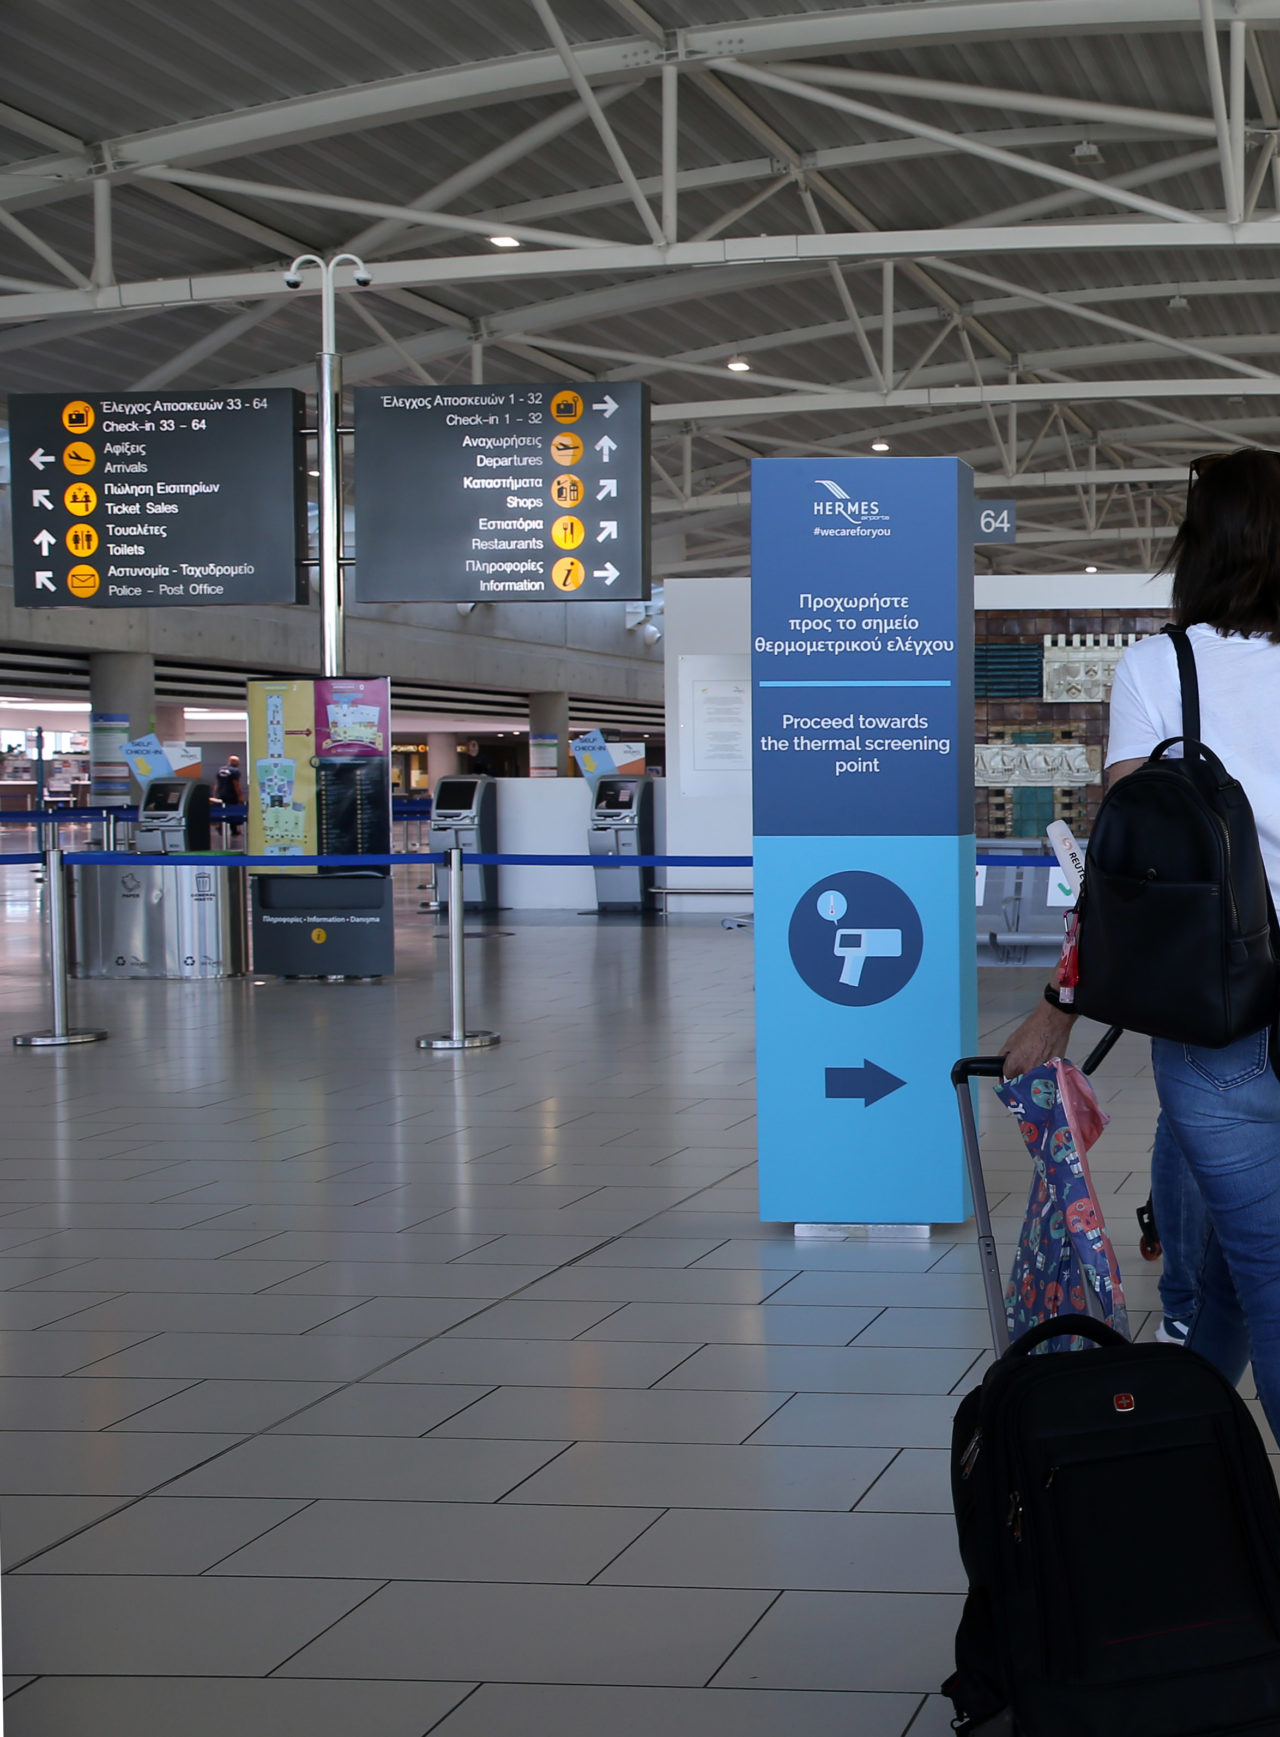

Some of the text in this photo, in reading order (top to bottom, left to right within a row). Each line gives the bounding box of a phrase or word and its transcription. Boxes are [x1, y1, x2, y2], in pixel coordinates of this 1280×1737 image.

[153, 400, 223, 411] Αποσκευών
[227, 399, 241, 409] 33
[253, 398, 267, 409] 64
[434, 394, 504, 405] Αποσκευών
[509, 394, 514, 404] 1
[528, 393, 542, 404] 32
[103, 421, 155, 432] Check-in
[160, 420, 175, 431] 33
[192, 419, 206, 430] 64
[446, 415, 498, 425] Check-in
[506, 414, 509, 424] 1
[529, 413, 542, 423] 32
[104, 442, 146, 455] Αφίξεις
[463, 435, 541, 449] Αναχωρήσεις
[105, 462, 147, 473] Arrivals
[477, 455, 543, 468] Departures
[105, 482, 219, 496] Πώληση Εισιτηρίων
[464, 476, 542, 490] Καταστήματα
[105, 502, 178, 514] Ticket Sales
[507, 496, 543, 509] Shops
[814, 502, 880, 519] HERMES
[106, 524, 167, 537] Τουαλέτες
[479, 518, 543, 531] Εστιατόρια
[814, 527, 890, 538] #wecareforyou
[107, 544, 145, 555] Toilets
[472, 538, 543, 549] Restaurants
[108, 565, 169, 578] Αστυνομία
[180, 563, 254, 577] Ταχυδρομείο
[466, 560, 543, 573] Πληροφορίες
[109, 585, 142, 595] Police
[160, 584, 183, 595] Post
[189, 584, 223, 594] Office
[480, 579, 544, 591] Information
[800, 593, 908, 612] Προχωρήστε
[789, 615, 918, 633] προς το σημείο
[755, 636, 953, 655] θερμομετρικού ελέγχου
[783, 714, 928, 728] Proceed towards
[761, 736, 949, 754] the thermal screening
[836, 758, 879, 776] point
